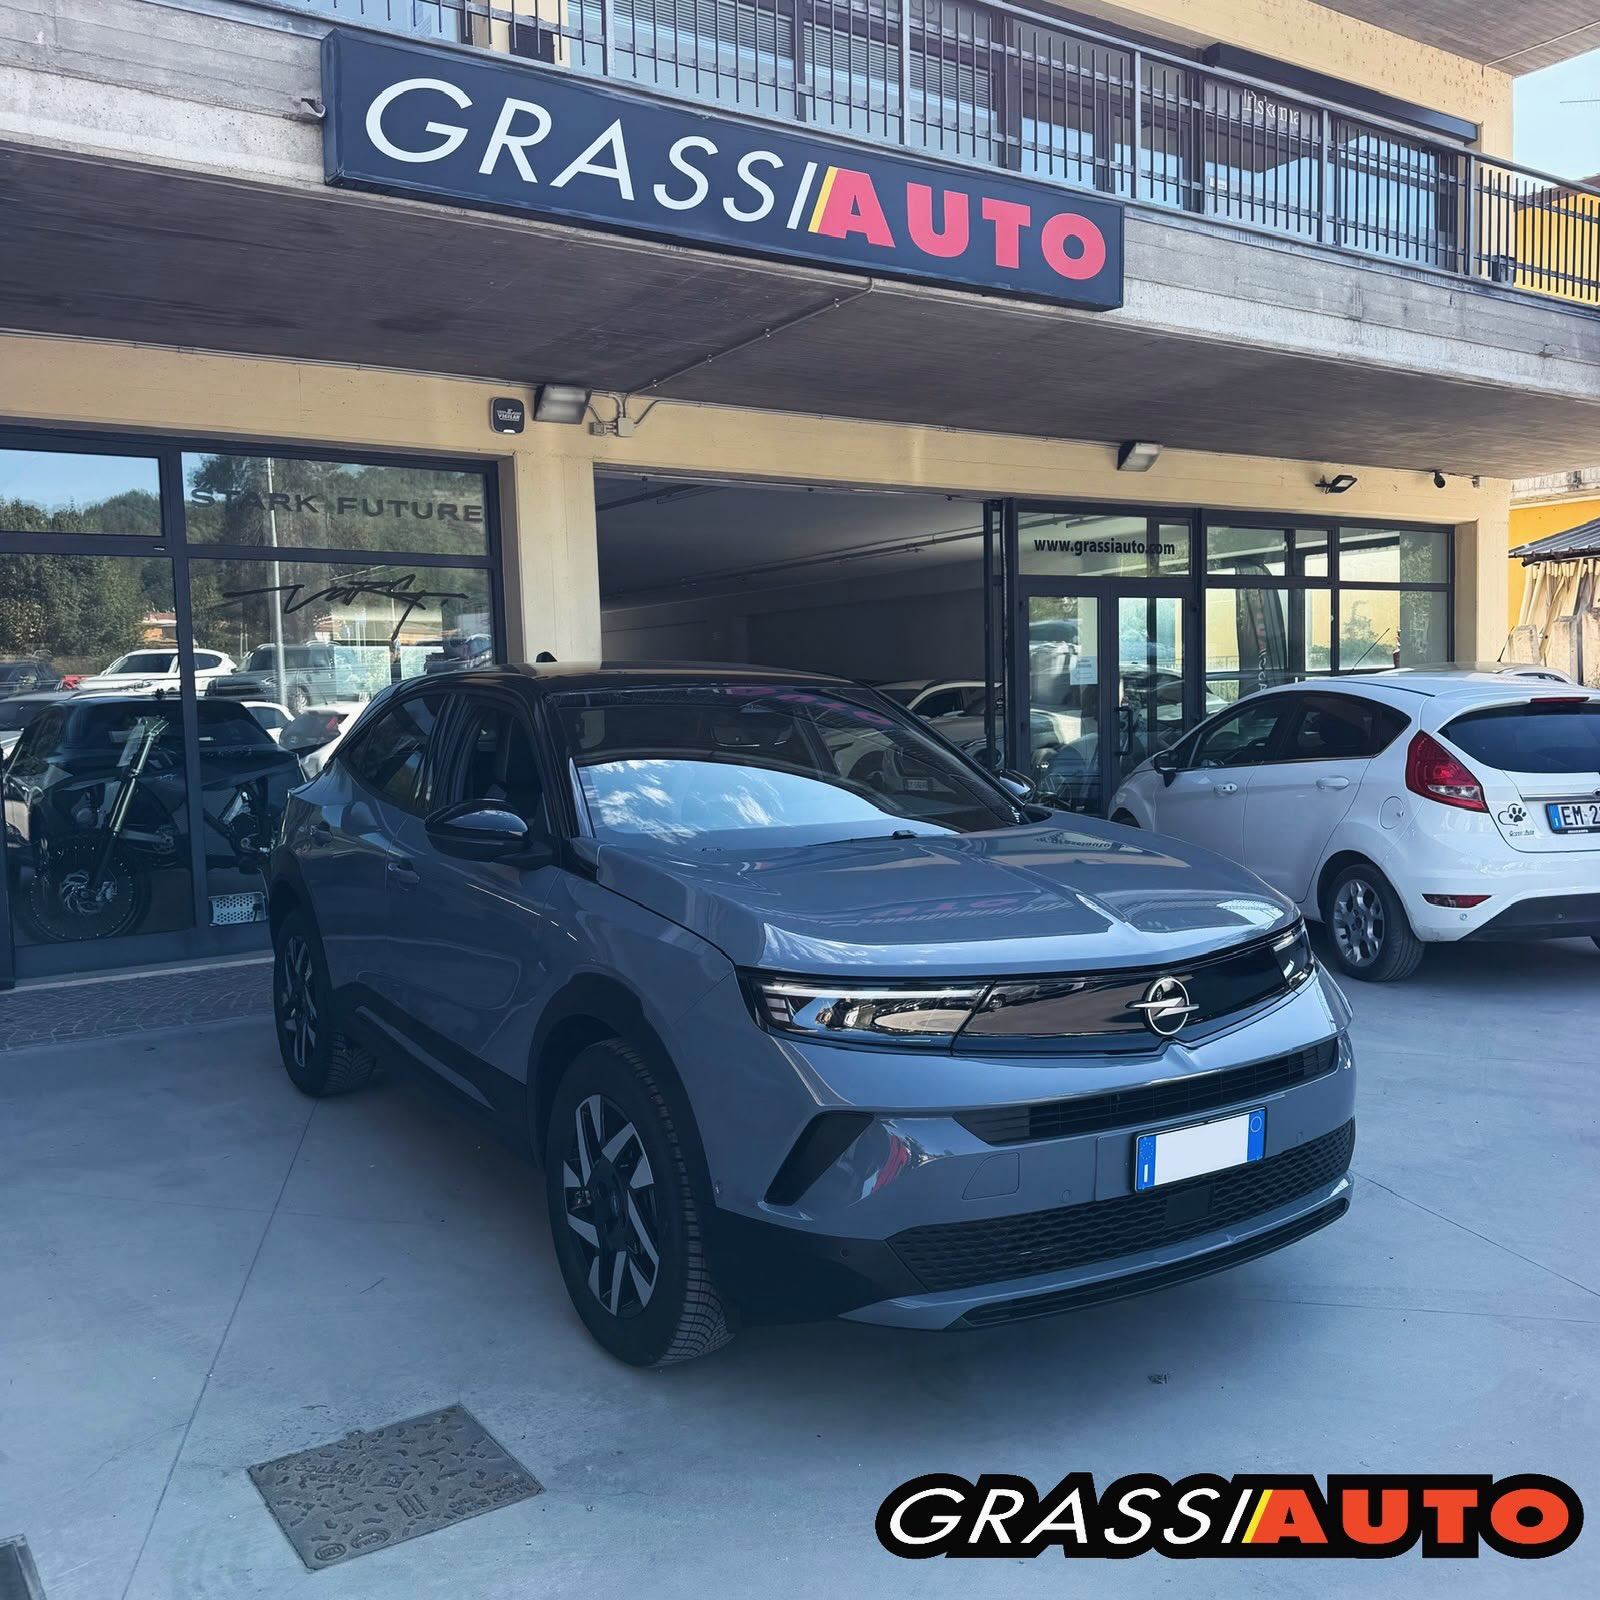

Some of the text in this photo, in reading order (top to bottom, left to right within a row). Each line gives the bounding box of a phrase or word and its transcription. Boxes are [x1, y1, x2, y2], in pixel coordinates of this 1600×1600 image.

[191, 486, 484, 523] STARK FUTURE
[1034, 538, 1176, 556] www.grassiauto.com
